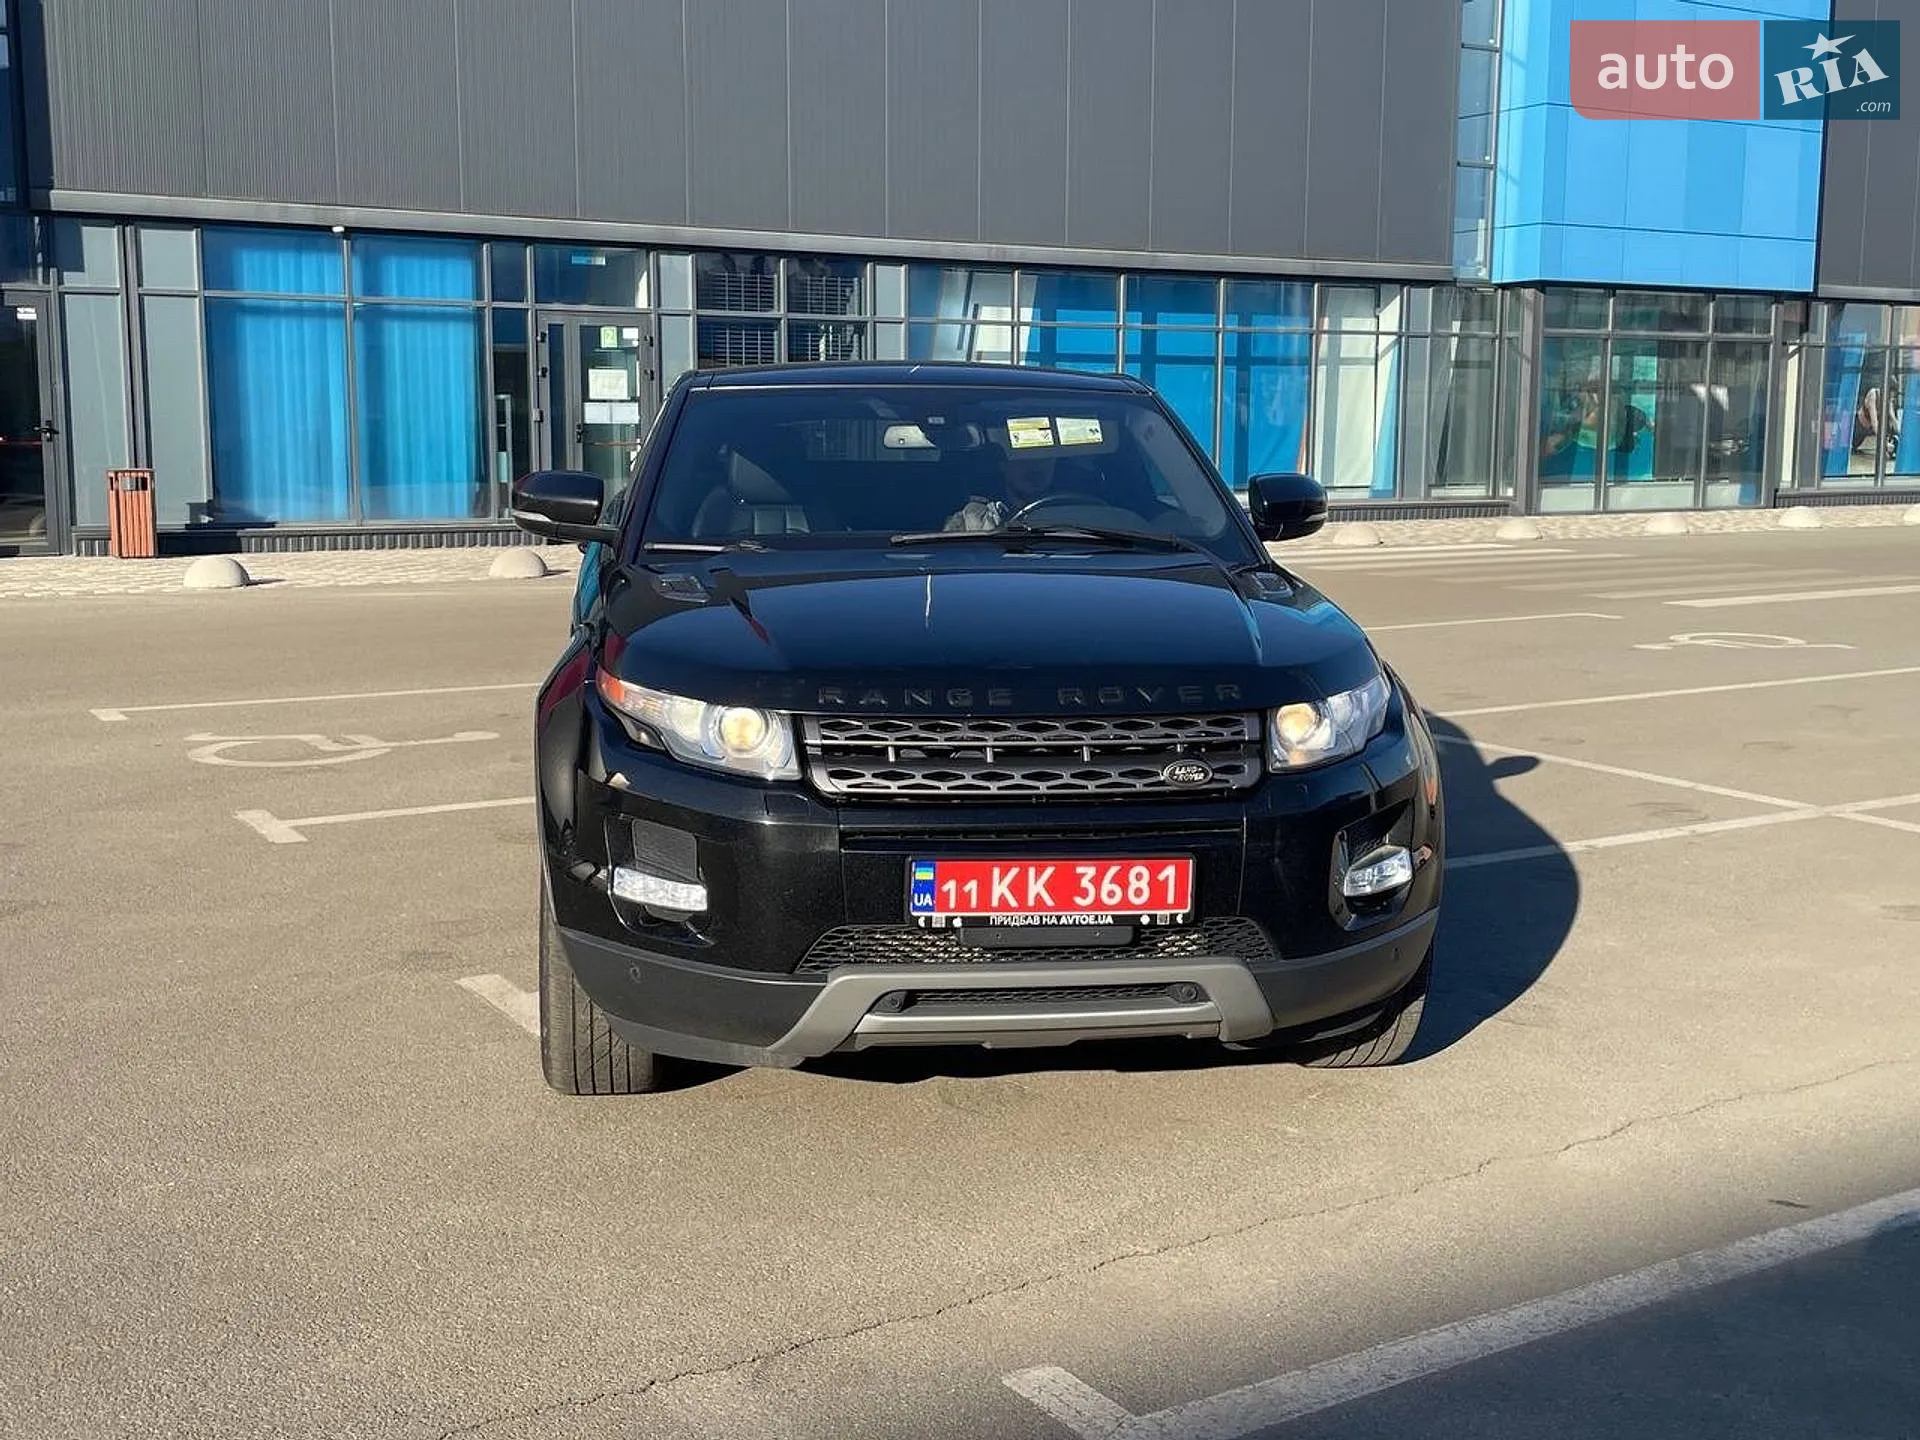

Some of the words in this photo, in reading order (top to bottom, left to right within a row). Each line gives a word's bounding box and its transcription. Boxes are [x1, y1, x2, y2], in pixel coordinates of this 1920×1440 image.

[818, 686, 1013, 706] RANGE
[1057, 684, 1241, 705] ROVER
[941, 878, 978, 909] 11
[1072, 864, 1176, 907] 3681
[914, 893, 933, 906] UA
[989, 914, 1040, 927] ПРИДБАВ
[1059, 914, 1114, 925] AVTOE.UA
